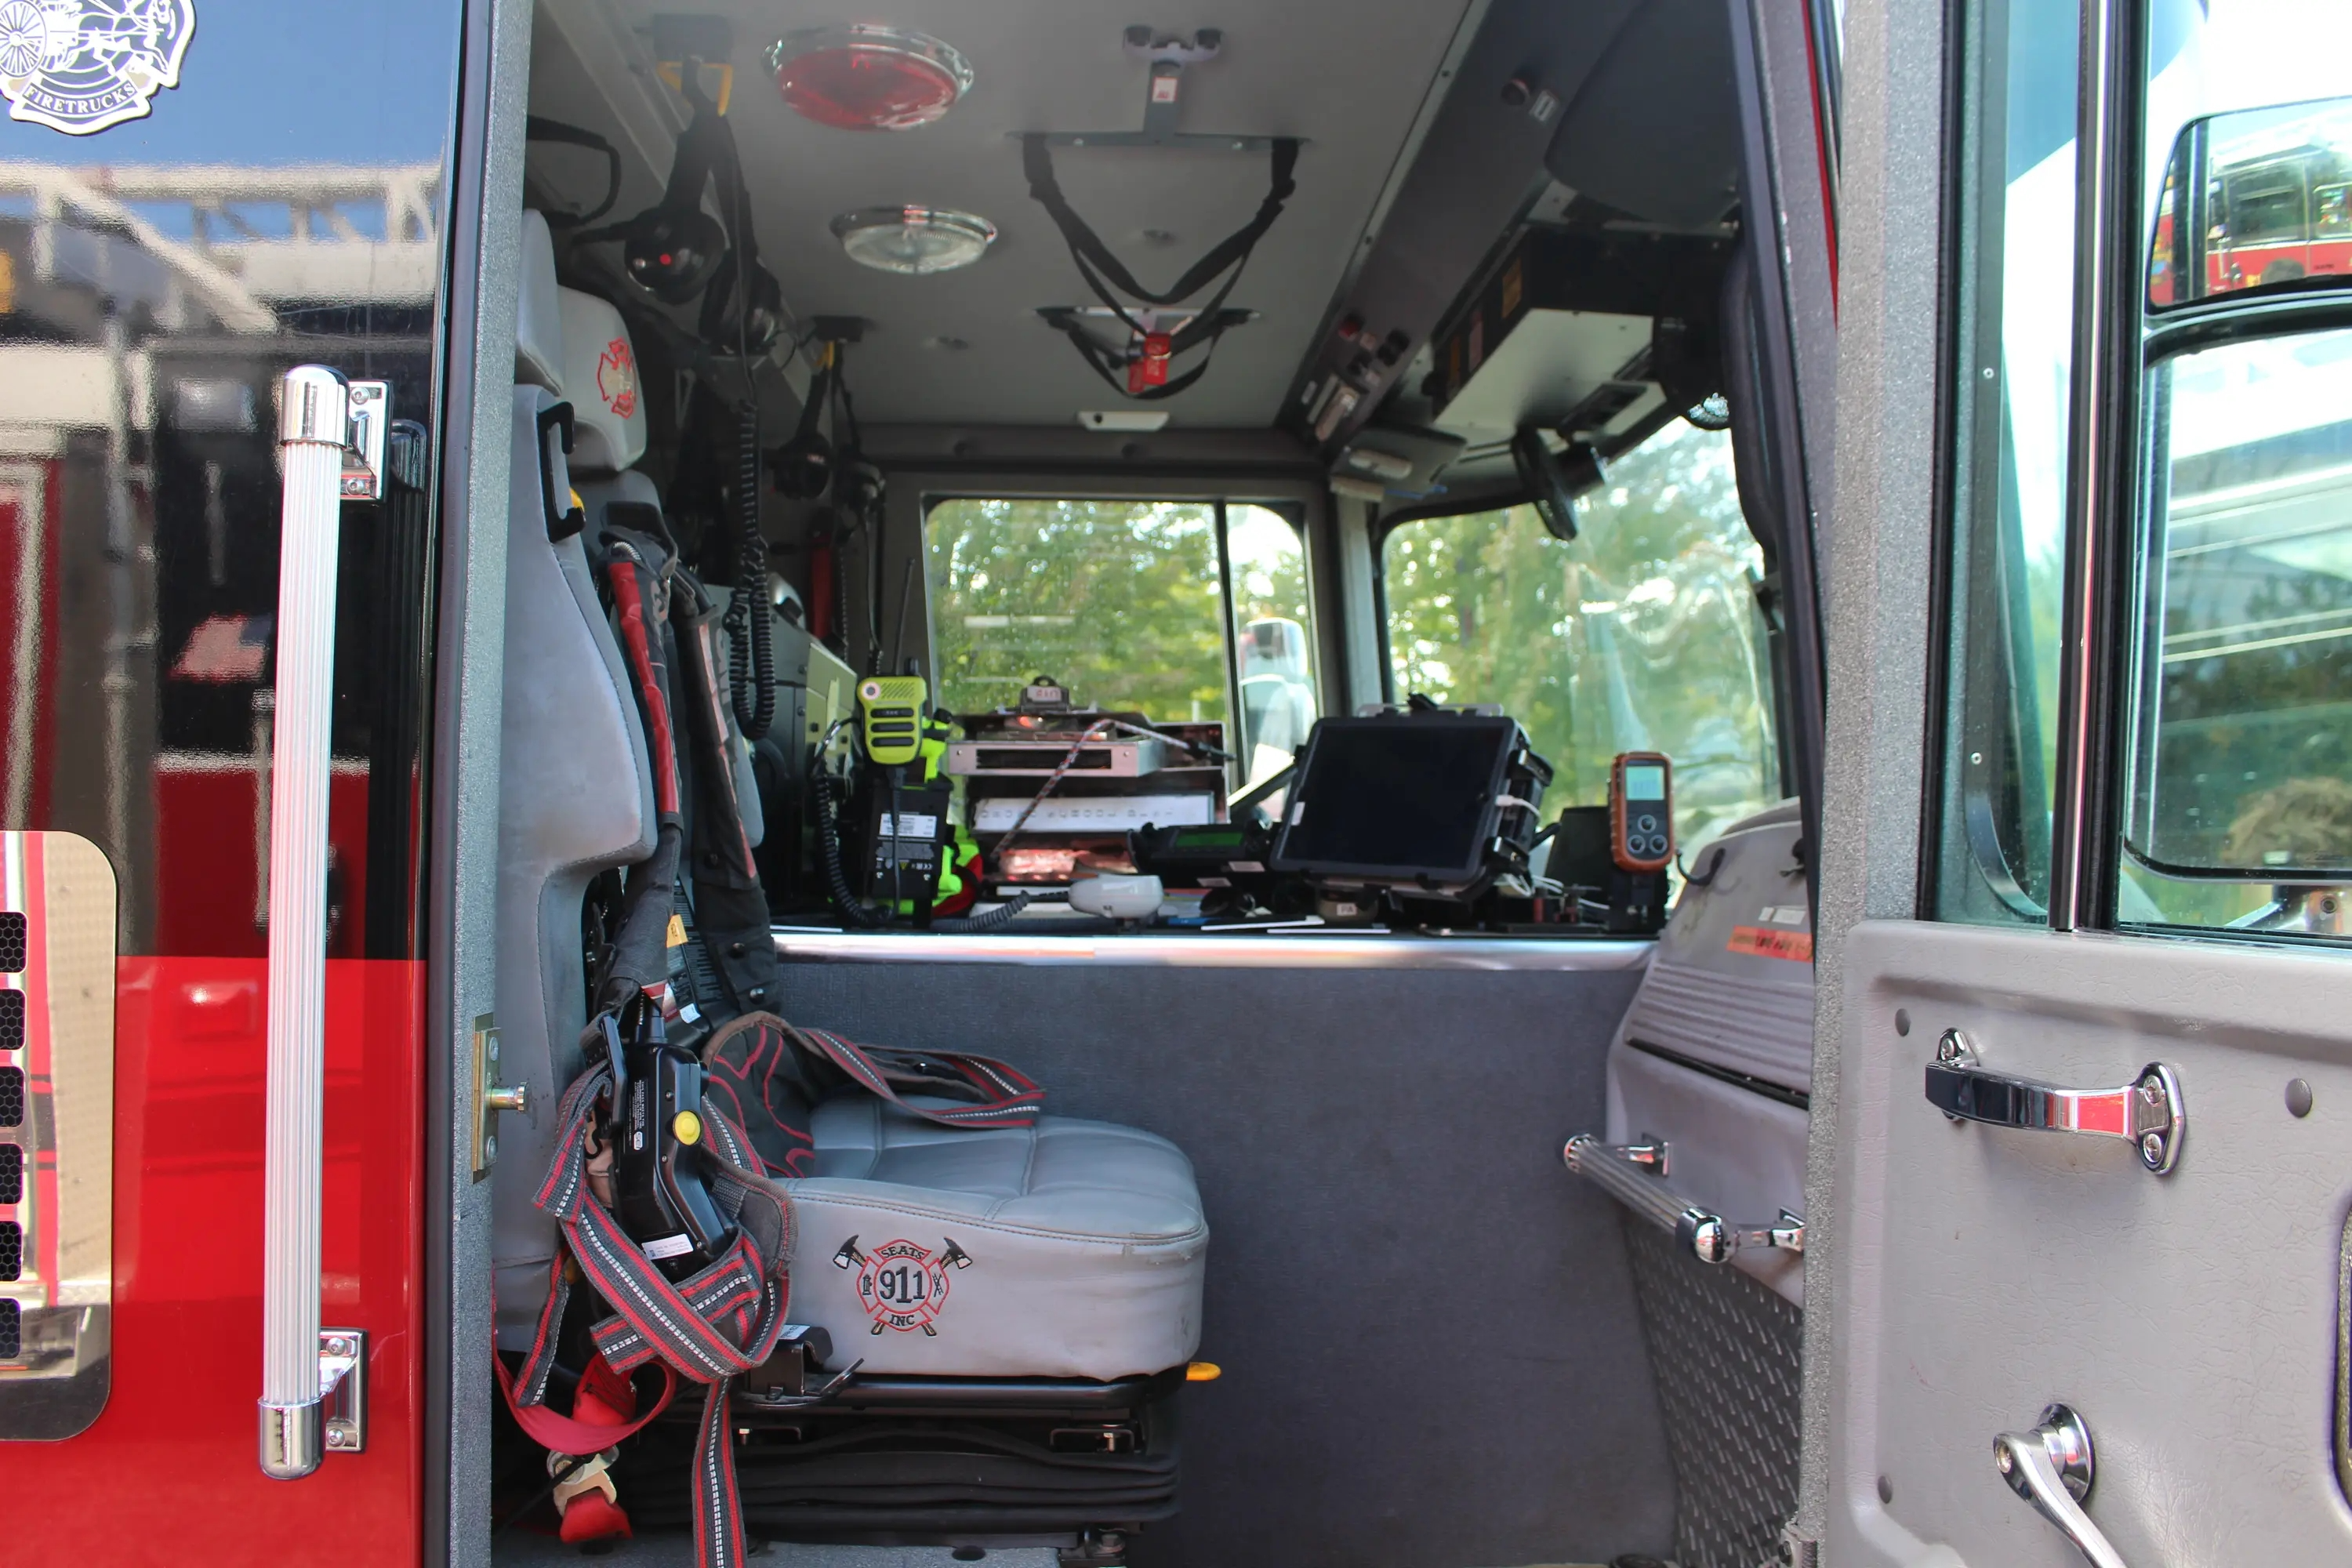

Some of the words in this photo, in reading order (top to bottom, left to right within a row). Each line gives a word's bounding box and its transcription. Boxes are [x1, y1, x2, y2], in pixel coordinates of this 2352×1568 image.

[24, 82, 137, 114] FIRETRUCKS
[880, 1245, 925, 1260] SEATS
[880, 1266, 926, 1303] 911
[889, 1314, 916, 1325] INC
